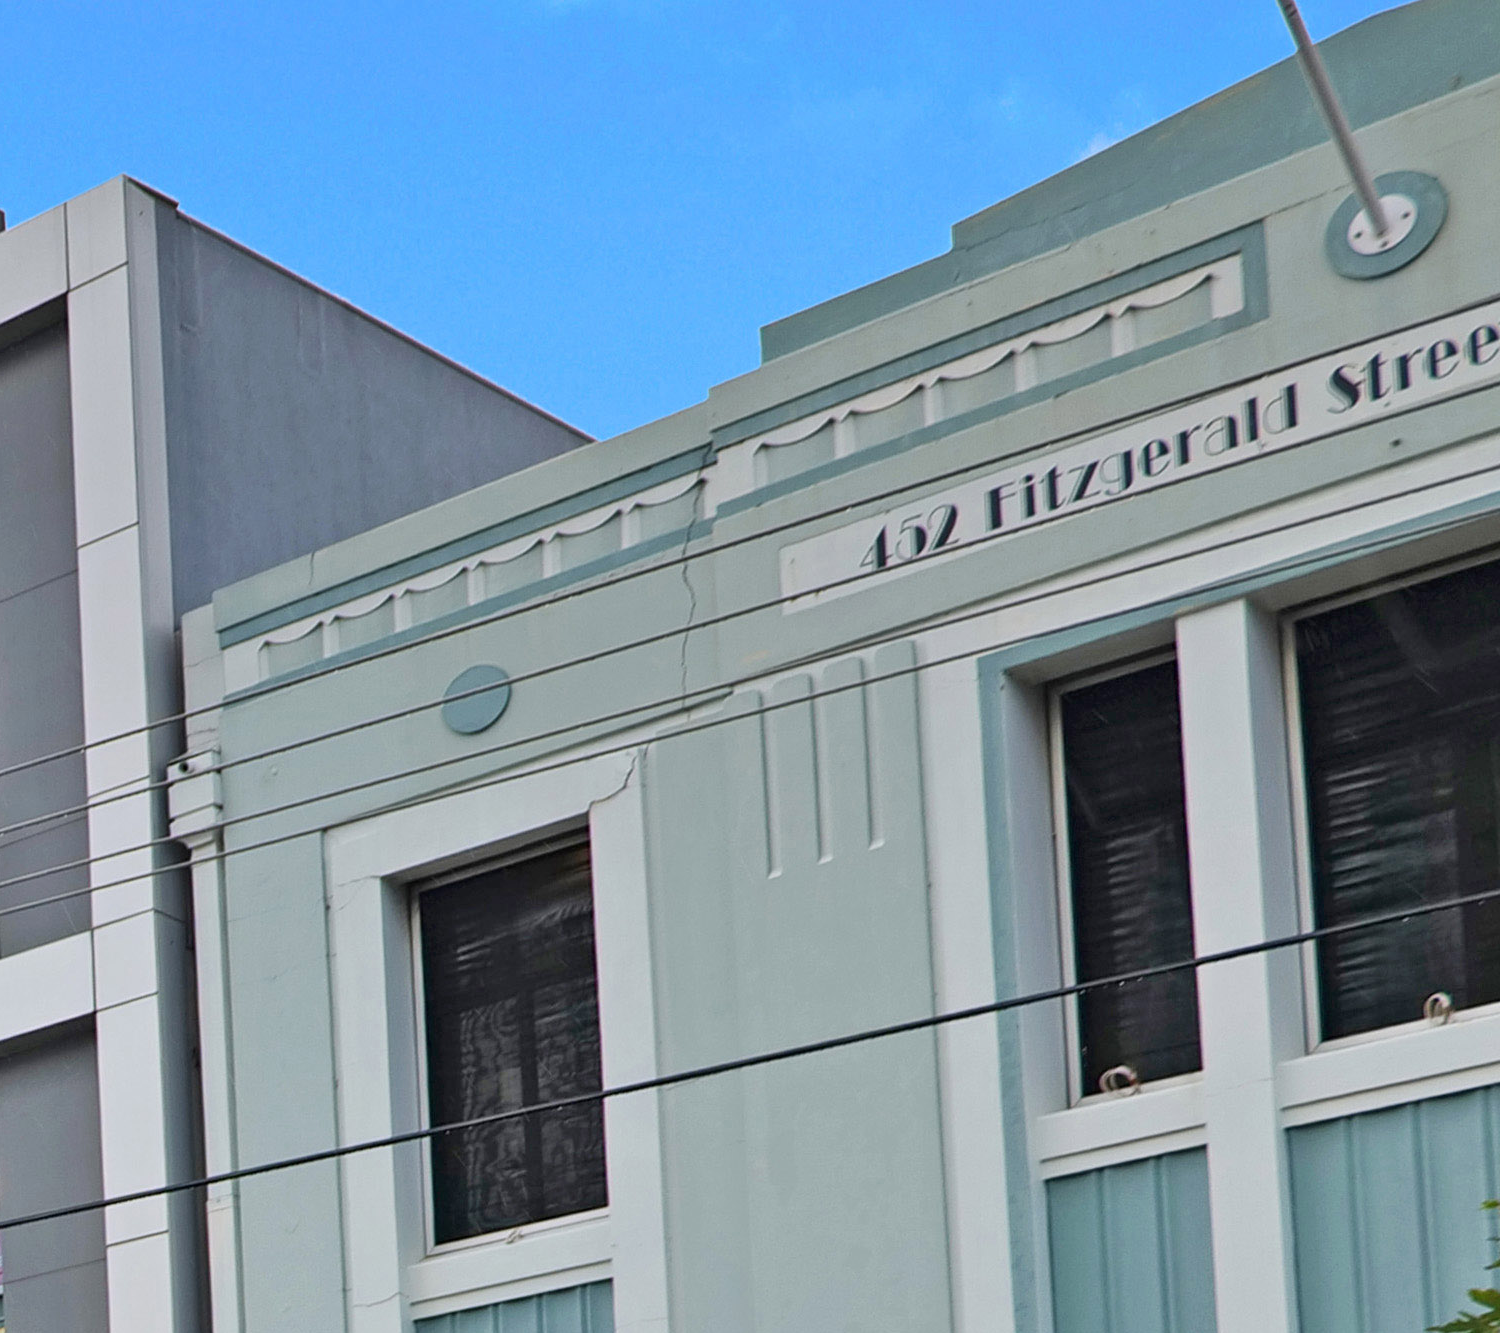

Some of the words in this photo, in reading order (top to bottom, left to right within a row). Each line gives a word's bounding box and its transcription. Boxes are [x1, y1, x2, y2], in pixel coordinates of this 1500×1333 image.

[859, 502, 960, 571] 452
[983, 381, 1299, 534] Fitzgerald
[1326, 324, 1500, 414] Stree
